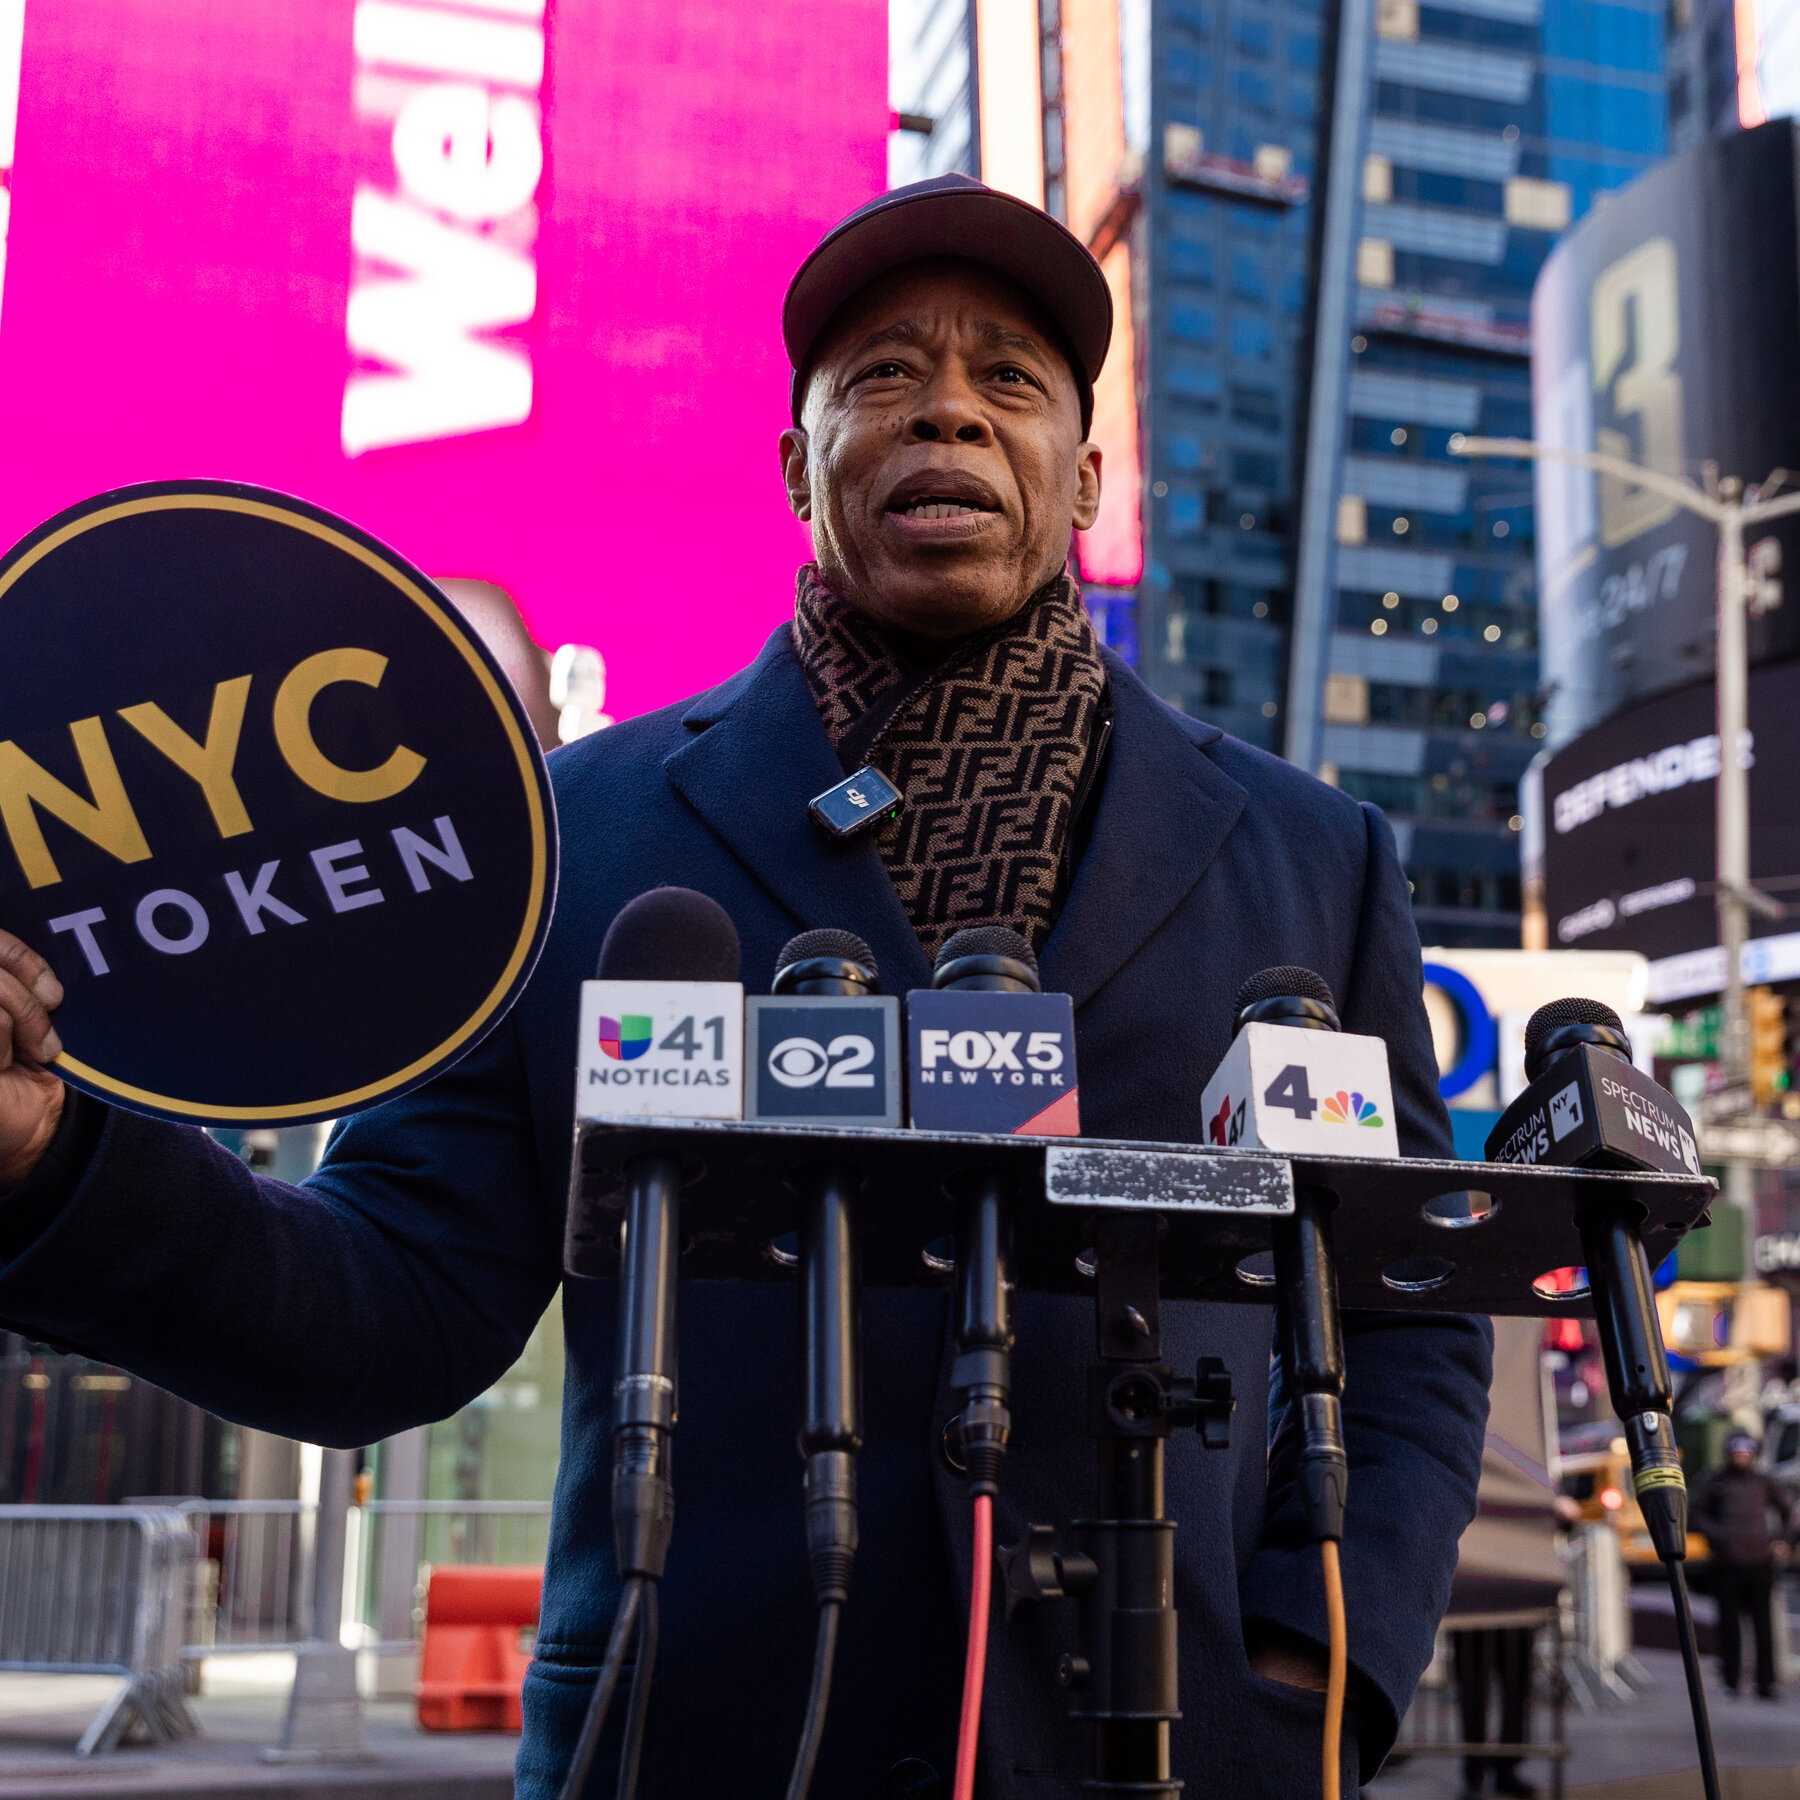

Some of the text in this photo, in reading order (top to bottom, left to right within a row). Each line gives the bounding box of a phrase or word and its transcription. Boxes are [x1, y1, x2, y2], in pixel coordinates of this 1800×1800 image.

[341, 0, 545, 459] Wel
[0, 647, 427, 889] NYC
[49, 815, 474, 977] TOKEN
[659, 1015, 725, 1061] 41
[825, 1035, 875, 1088] 2
[920, 1029, 1064, 1071] FOX 5
[589, 1068, 731, 1086] NOTICIAS
[921, 1071, 1065, 1087] NEW YORK
[1263, 1064, 1318, 1121] 4
[1228, 1097, 1247, 1146] 47
[1552, 1092, 1569, 1115] NY
[1569, 1101, 1580, 1124] 1
[1601, 1076, 1677, 1136] SPECTRUM
[1623, 1106, 1682, 1161] NEWS
